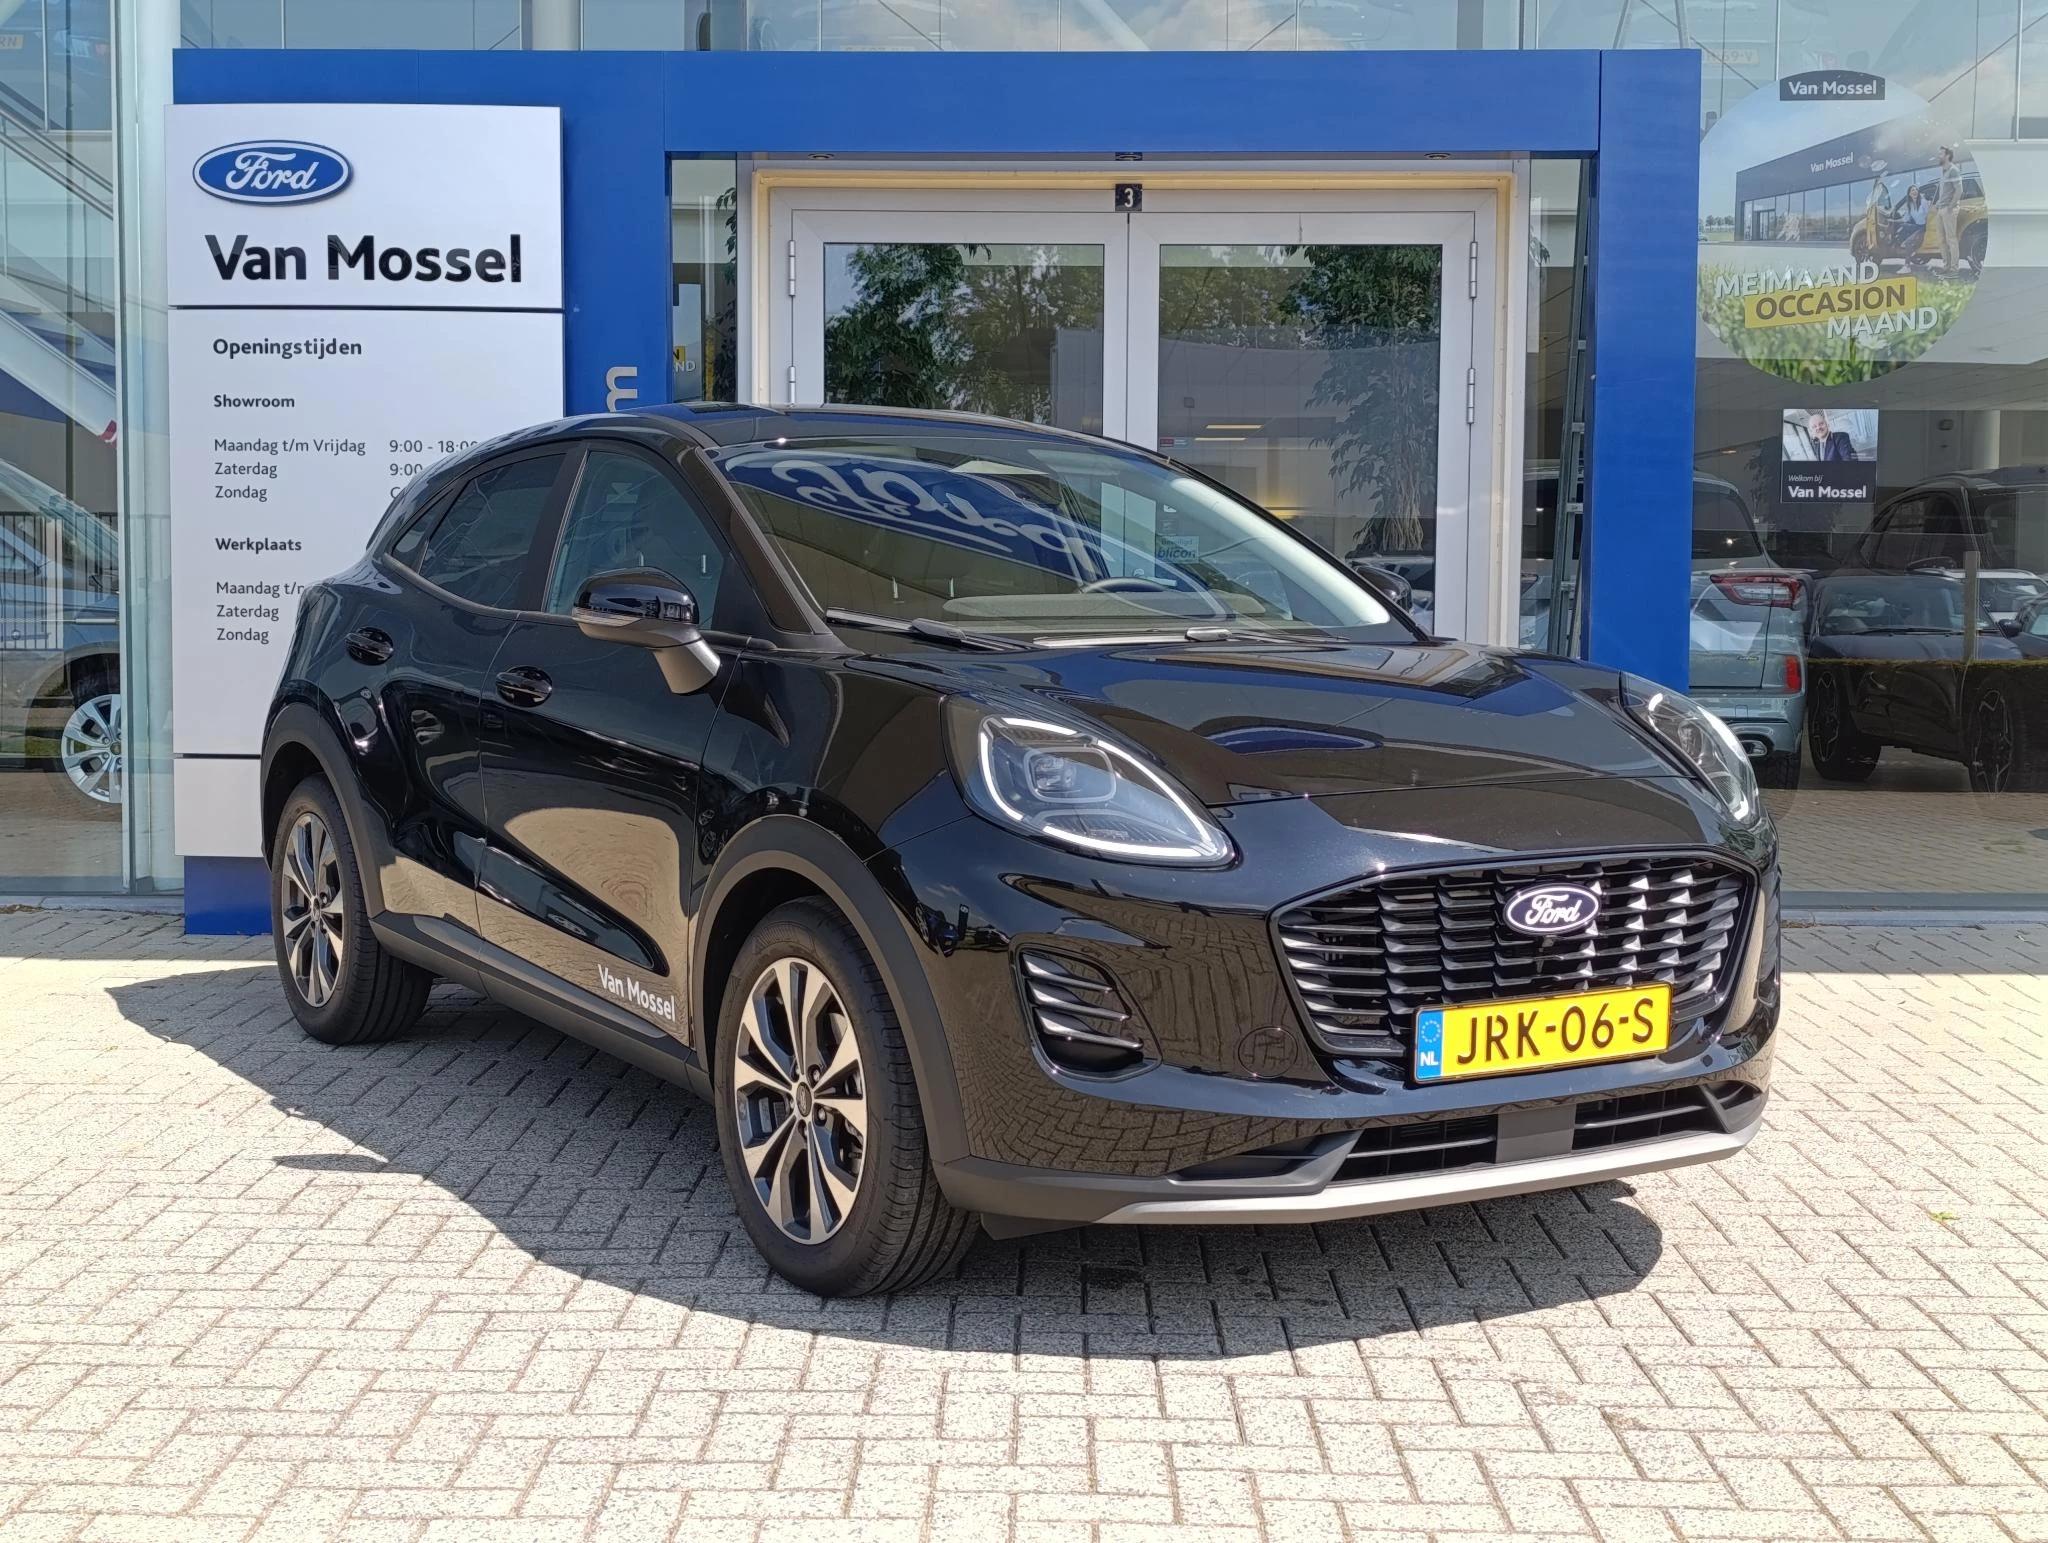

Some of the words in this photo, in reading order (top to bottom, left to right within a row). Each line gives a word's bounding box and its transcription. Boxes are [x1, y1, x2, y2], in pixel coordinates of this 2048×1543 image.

[1788, 81, 1818, 95] Van
[1822, 80, 1877, 95] Mossel
[225, 151, 320, 190] Ford
[1810, 162, 1824, 173] Van
[1825, 151, 1854, 170] Mossel
[1124, 187, 1134, 208] 3
[204, 234, 307, 281] Van
[327, 233, 522, 283] Mossel
[1715, 261, 1880, 299] MEIMAAND
[1755, 284, 1906, 321] OCCASION
[1826, 305, 1939, 340] MAAND
[213, 337, 362, 360] Openingstijden
[213, 394, 296, 408] Showroom
[214, 438, 279, 456] Maandag
[282, 438, 309, 453] t/m
[313, 438, 366, 457] Vrijdag
[389, 439, 423, 454] 9:00
[214, 461, 278, 479] Zaterdag
[1788, 474, 1814, 482] Welkom
[215, 485, 268, 502] Zondag
[1788, 485, 1815, 498] Van
[1818, 485, 1867, 498] Mossel
[215, 537, 302, 555] Werkplaats
[216, 580, 281, 599] Maandag
[216, 604, 280, 622] Zaterdag
[216, 627, 270, 645] Zondag
[1525, 894, 1584, 926] Ford
[598, 963, 625, 998] Van
[626, 976, 676, 1023] Mossel
[1456, 998, 1654, 1065] JRK-06-S
[1420, 1051, 1438, 1067] NL
